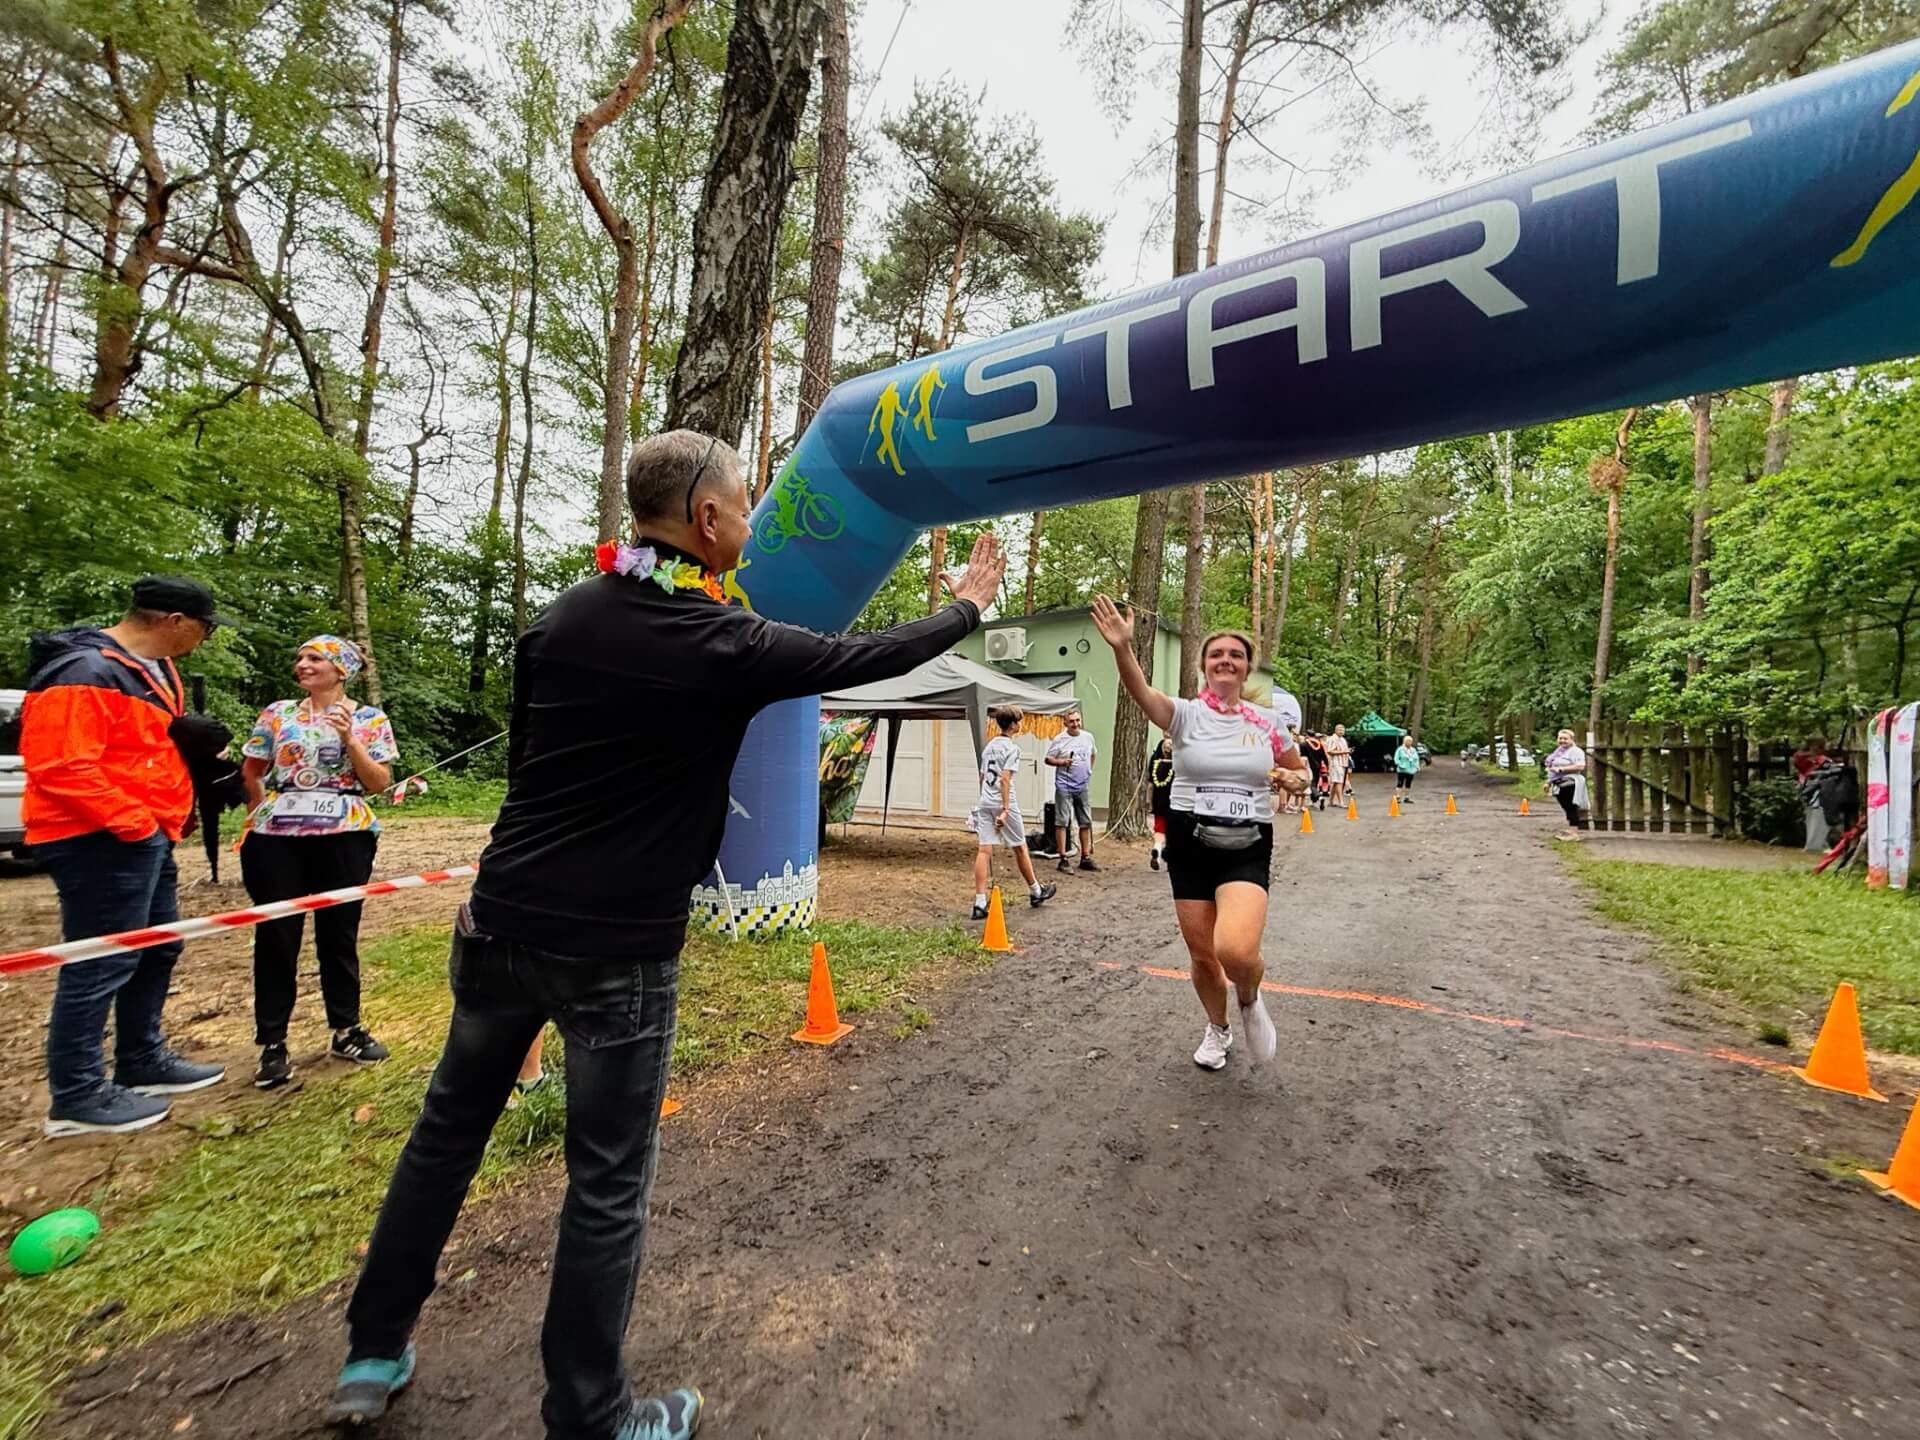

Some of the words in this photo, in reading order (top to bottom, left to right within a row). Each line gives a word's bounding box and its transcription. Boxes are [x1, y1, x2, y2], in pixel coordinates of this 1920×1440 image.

[964, 119, 1753, 443] START
[985, 759, 998, 787] 5
[312, 799, 335, 814] 165
[1229, 801, 1249, 816] 091
